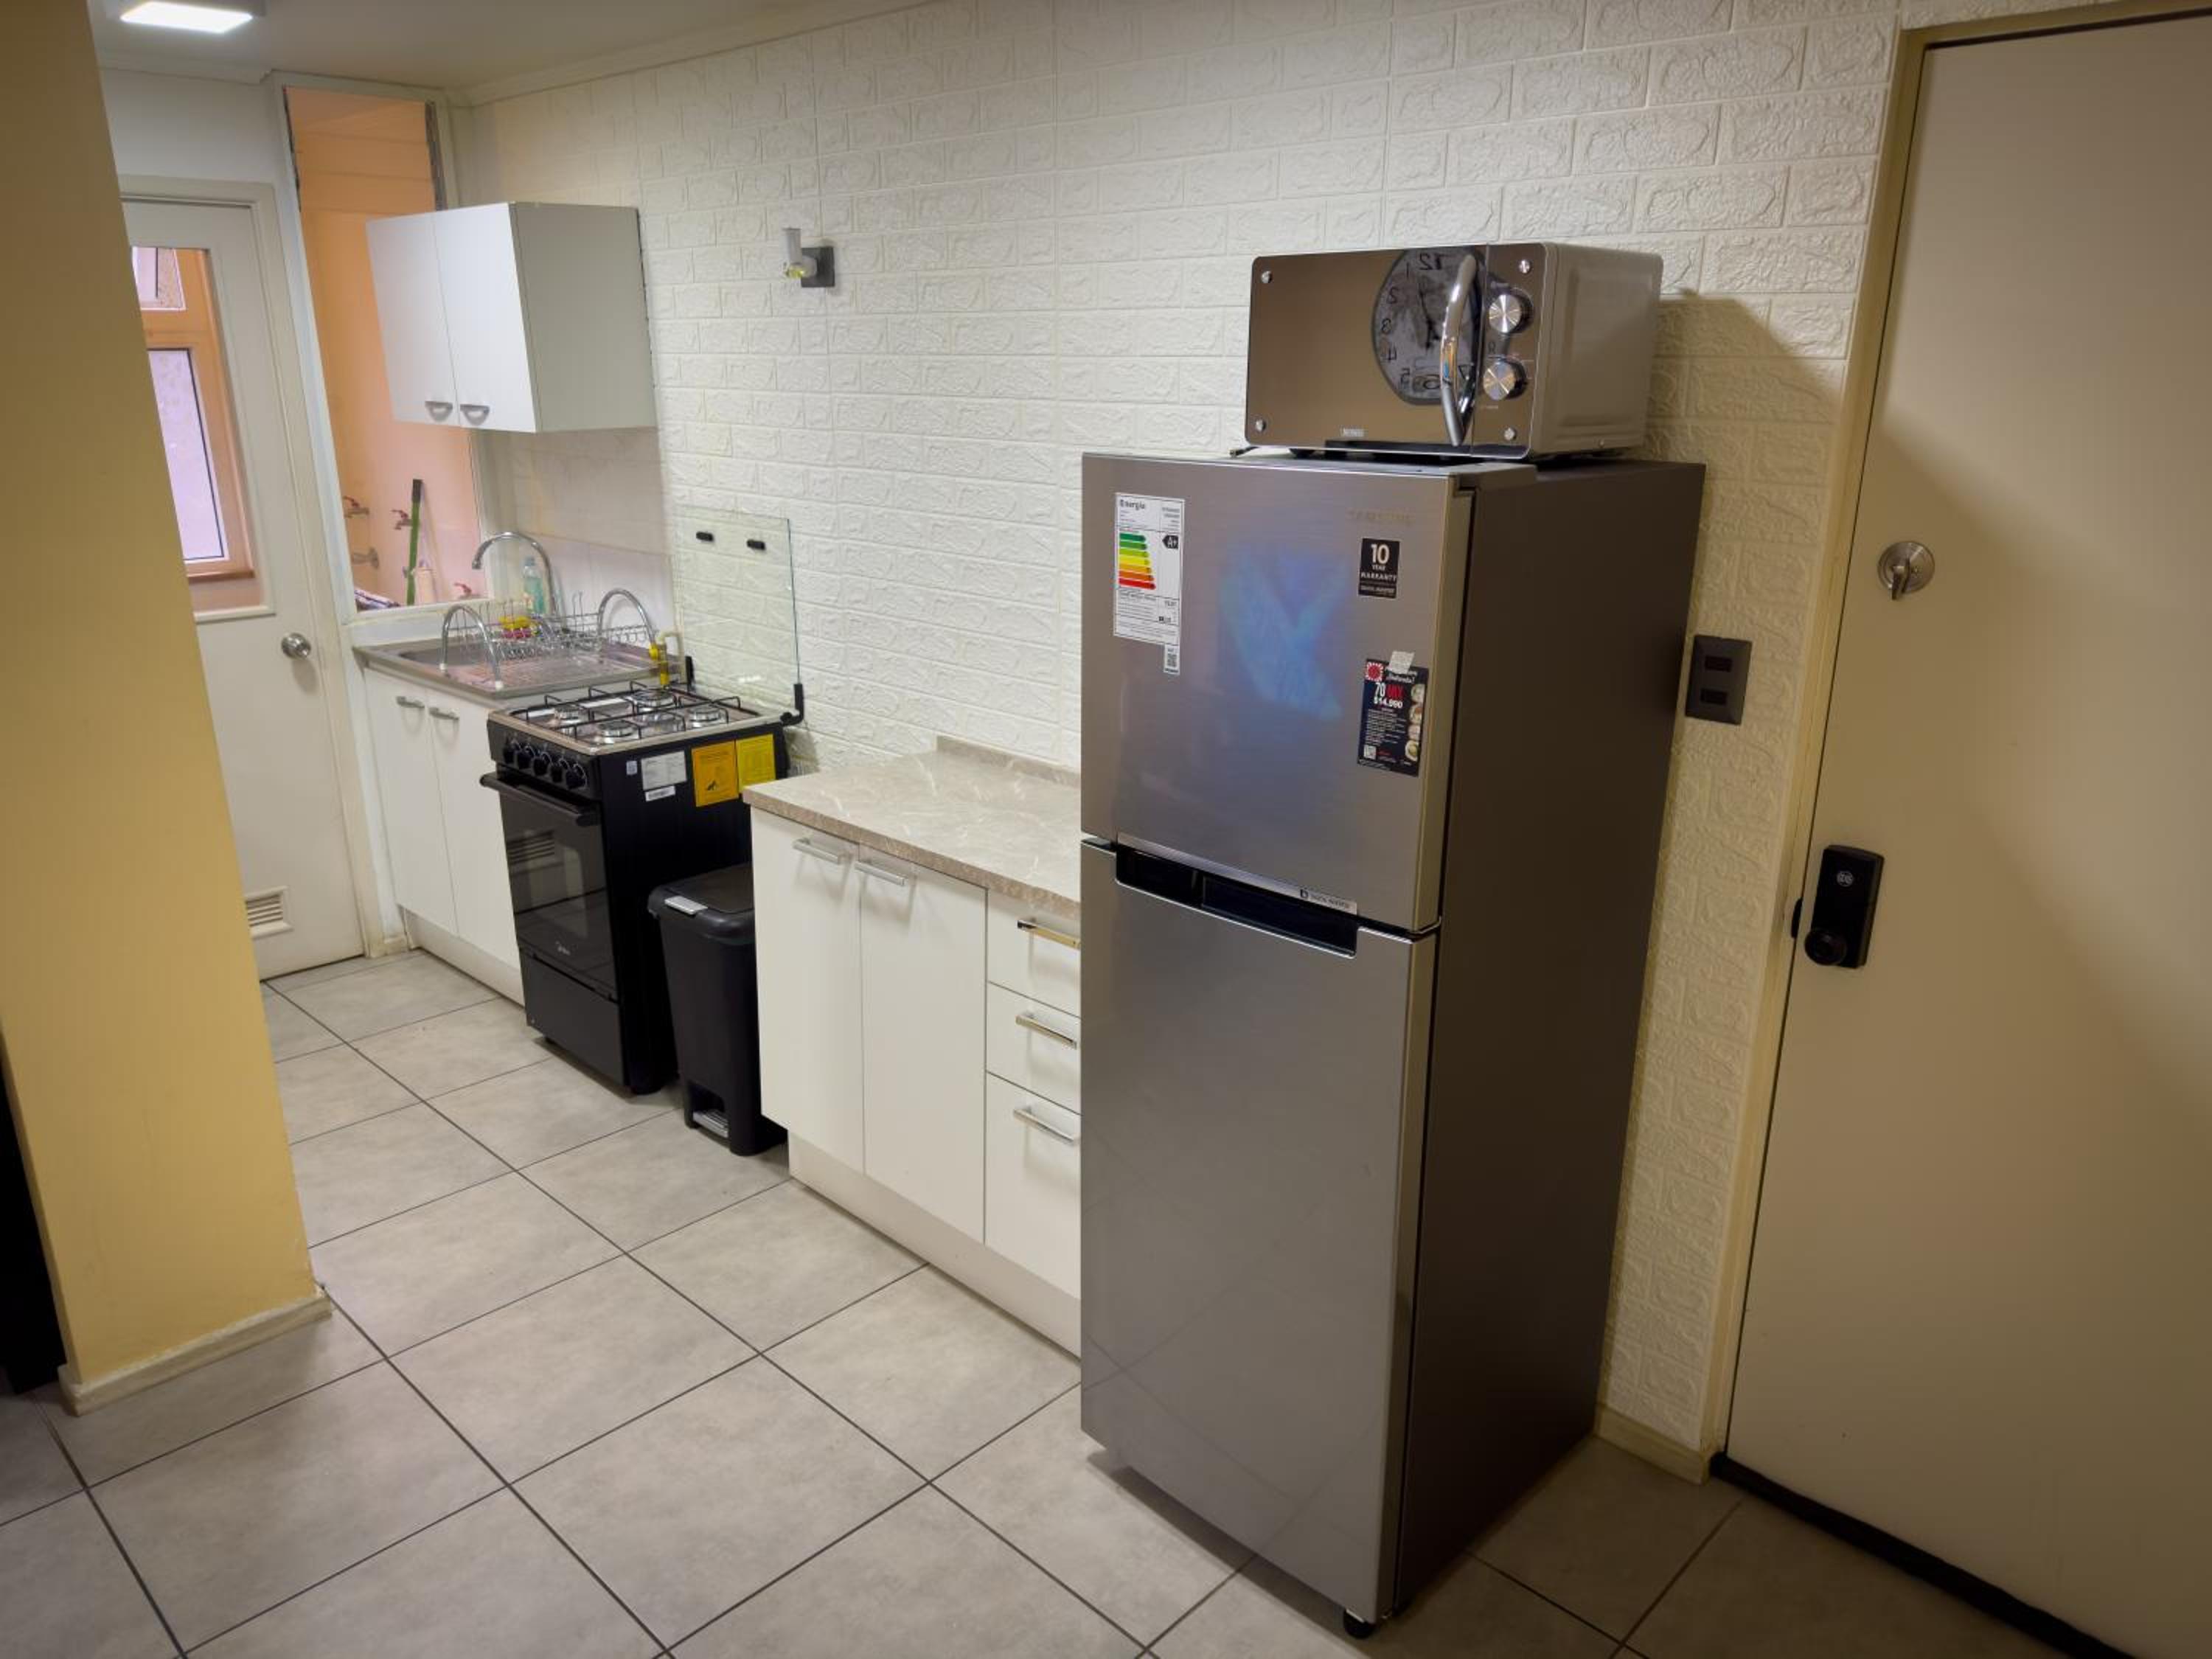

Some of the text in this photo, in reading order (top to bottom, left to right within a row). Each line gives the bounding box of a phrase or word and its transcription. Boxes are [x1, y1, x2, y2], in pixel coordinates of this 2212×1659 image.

[1371, 543, 1390, 565] 10
[1360, 572, 1397, 582] WARRANTY
[1375, 681, 1386, 698] 70
